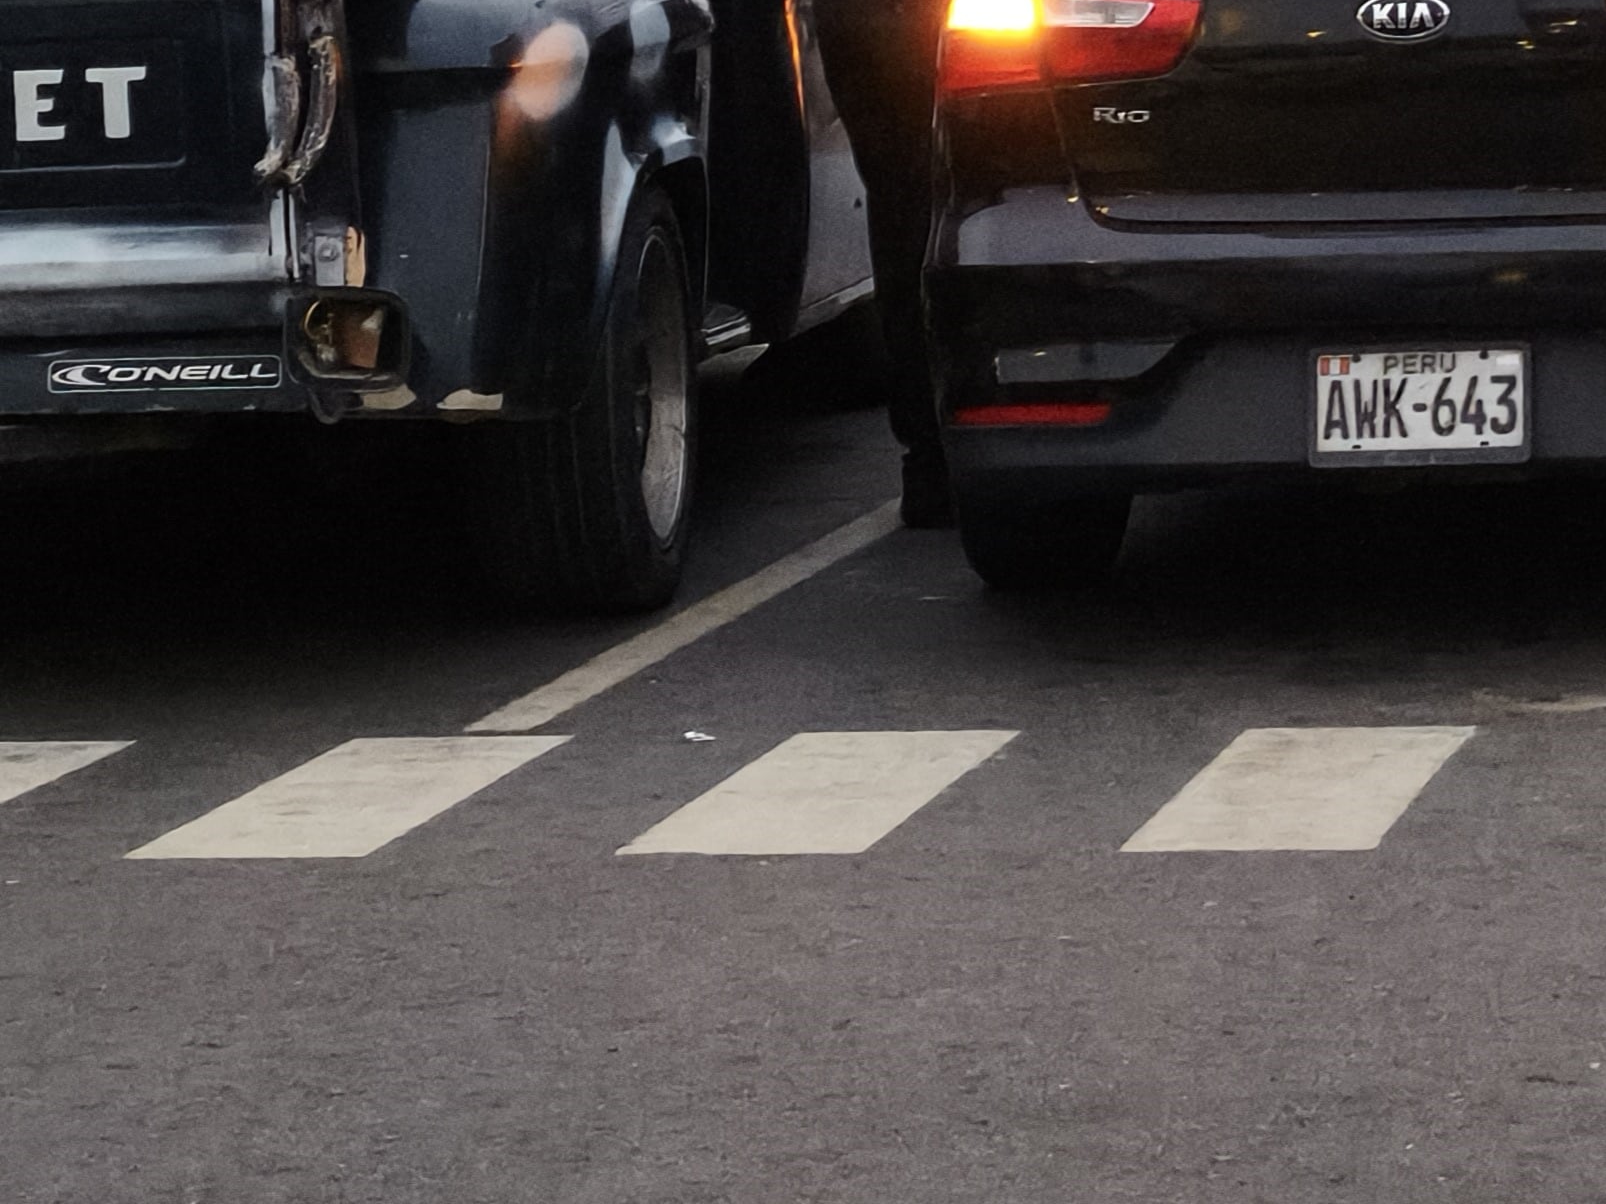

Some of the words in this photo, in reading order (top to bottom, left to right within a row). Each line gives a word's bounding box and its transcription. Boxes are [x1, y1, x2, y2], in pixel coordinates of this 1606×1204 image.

[1372, 1, 1435, 29] KIA
[13, 66, 147, 142] ET
[1093, 107, 1151, 124] Rio
[1383, 353, 1457, 376] PERU
[1323, 374, 1518, 441] AWK-643
